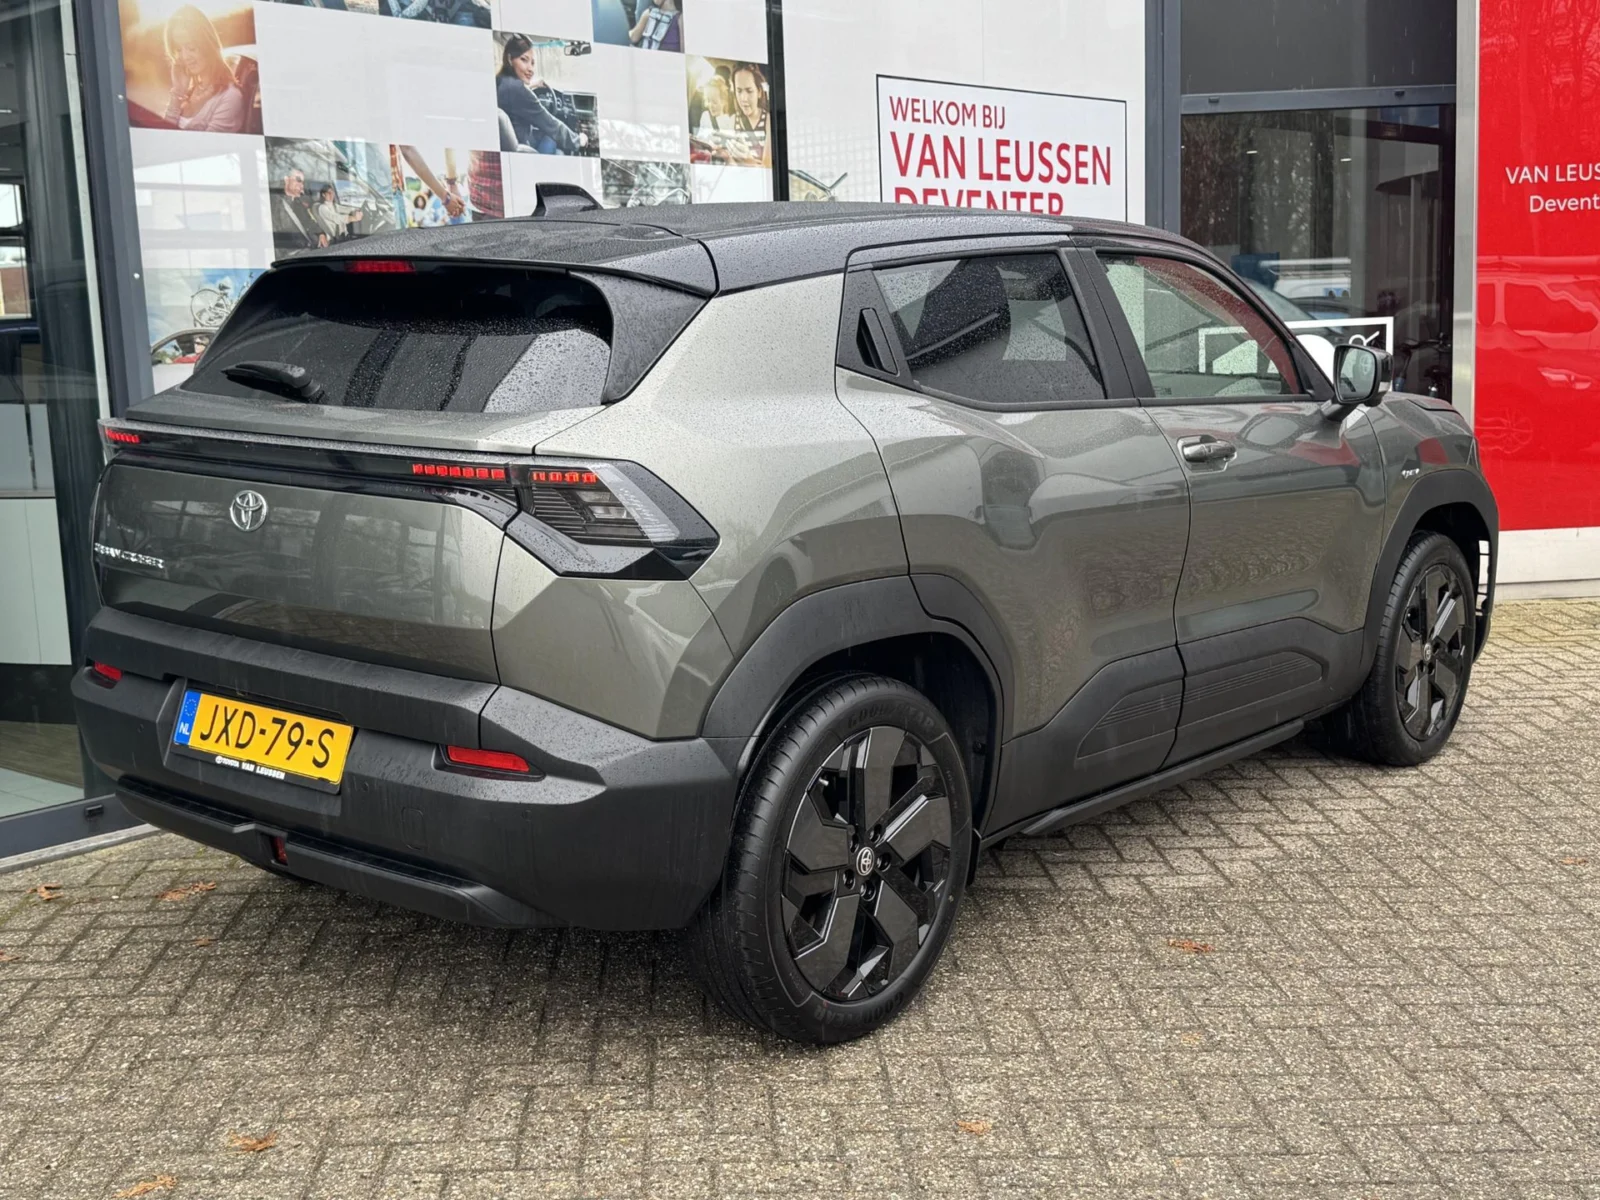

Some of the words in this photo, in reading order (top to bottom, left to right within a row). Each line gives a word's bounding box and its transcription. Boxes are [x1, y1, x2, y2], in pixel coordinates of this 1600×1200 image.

[889, 95, 976, 127] WELKOM
[982, 104, 1006, 129] BIJ
[890, 131, 966, 180] VAN
[978, 137, 1111, 186] LEUSSEN
[1505, 165, 1548, 184] VAN
[179, 721, 190, 735] NL
[200, 704, 335, 769] JXD-79-S
